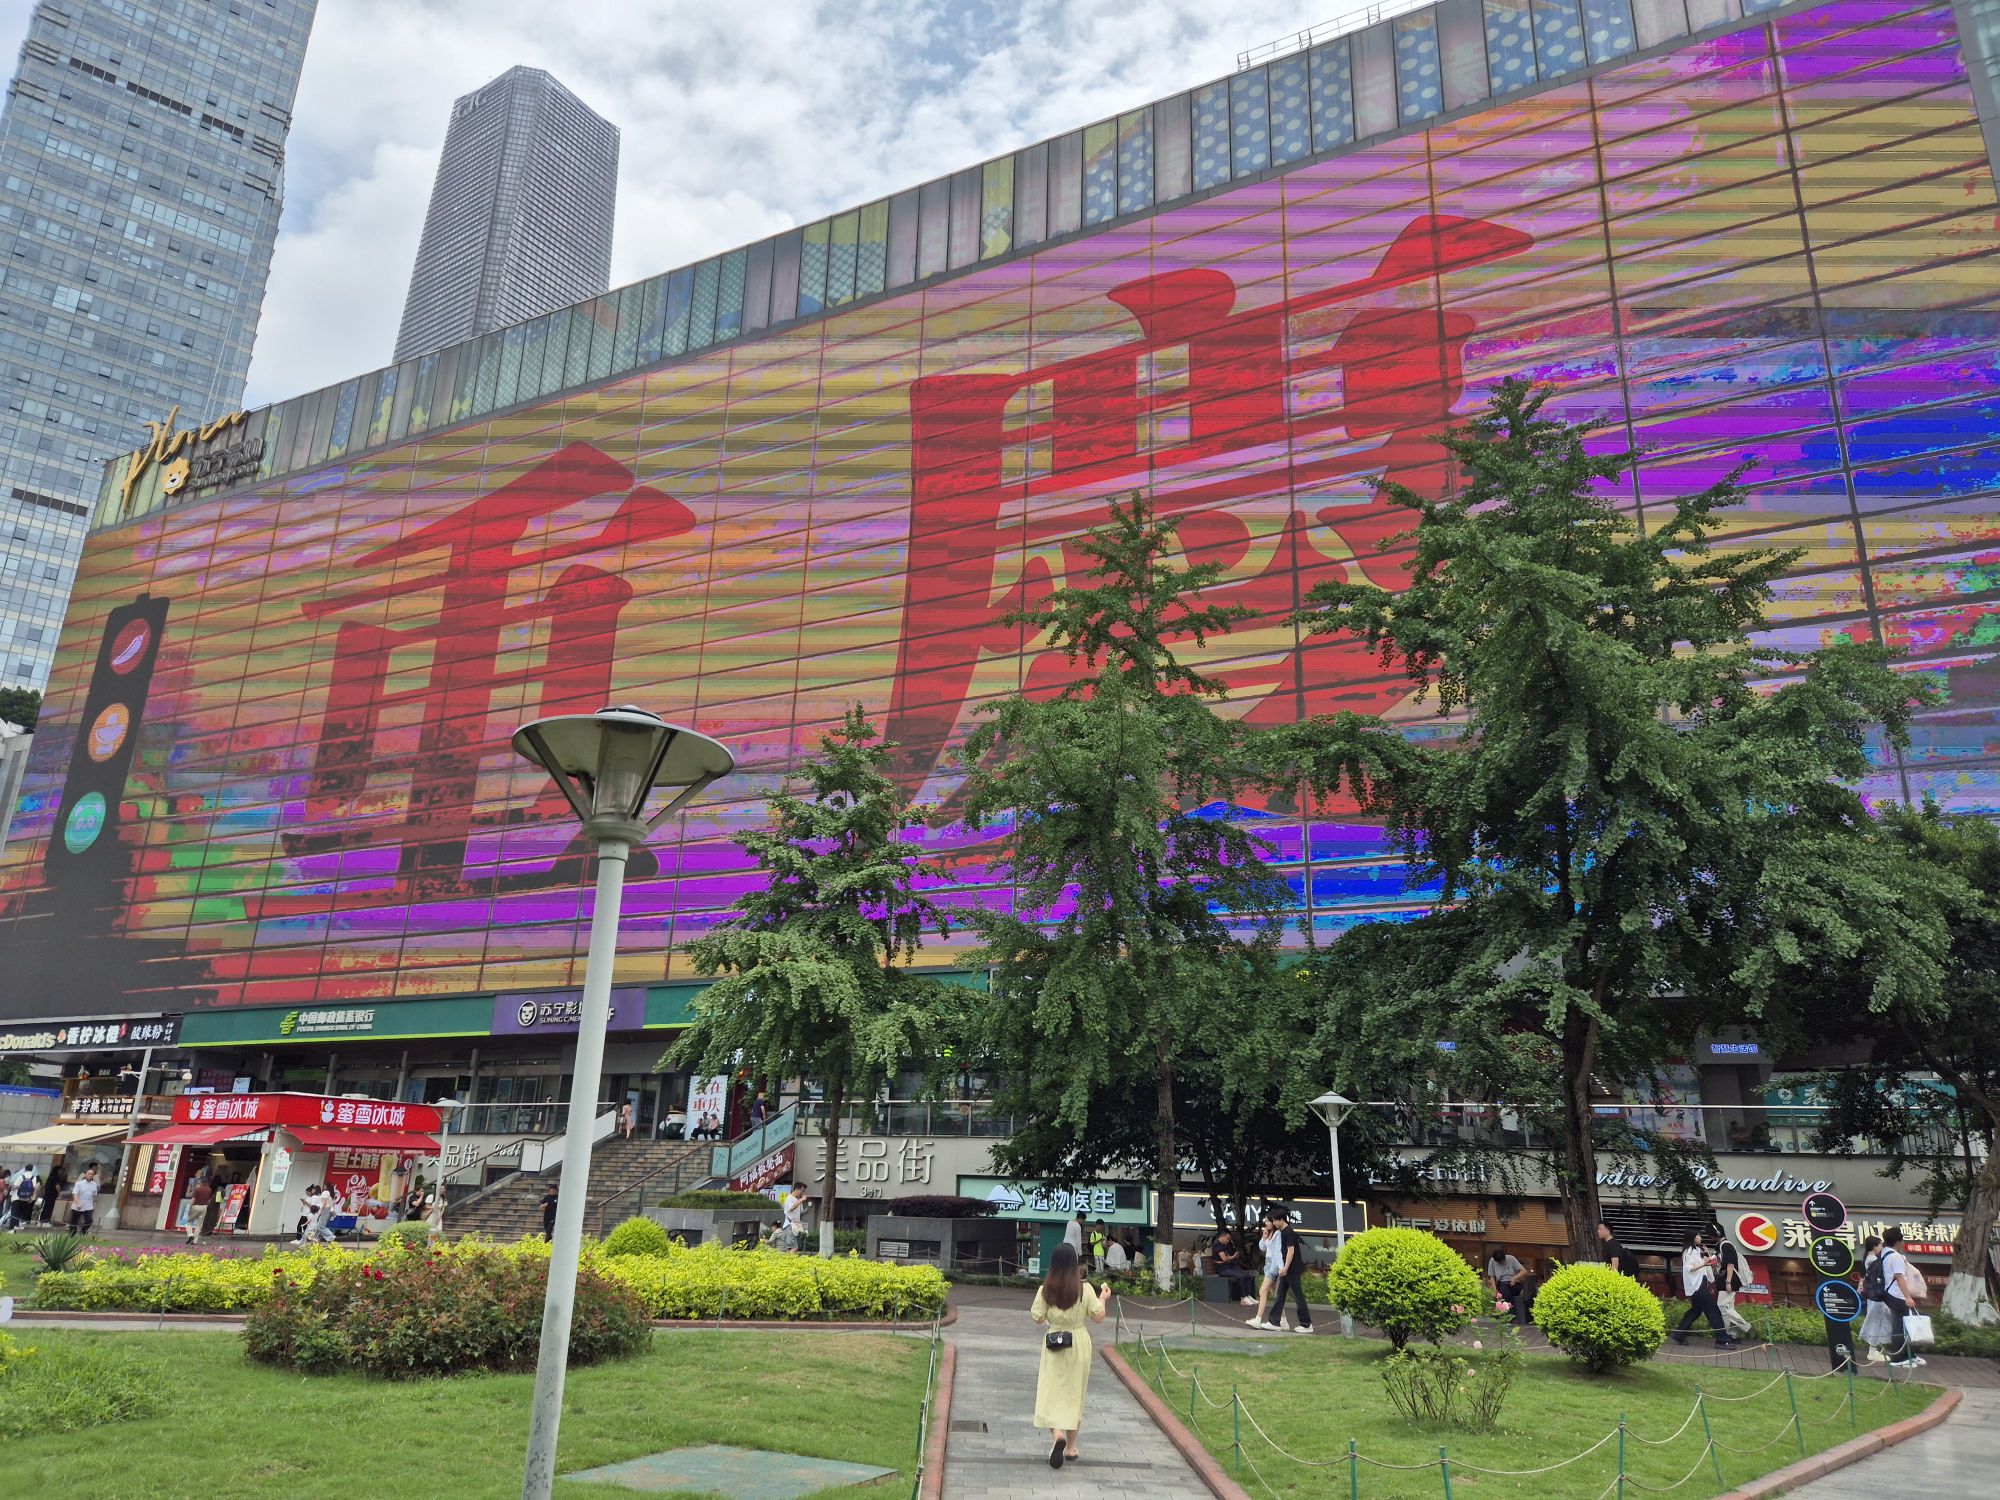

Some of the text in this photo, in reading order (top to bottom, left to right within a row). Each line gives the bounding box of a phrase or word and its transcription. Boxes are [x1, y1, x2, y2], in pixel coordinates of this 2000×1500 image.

[298, 1009, 376, 1025] 中国邮政储蓄银行
[0, 1032, 56, 1050] cDonald's
[200, 1097, 260, 1121] 蜜雪冰城
[335, 1102, 406, 1127] 蜜雪冰城
[692, 1097, 721, 1112] 重庆
[814, 1138, 935, 1185] 美品街
[1030, 1187, 1115, 1214] 植物医生
